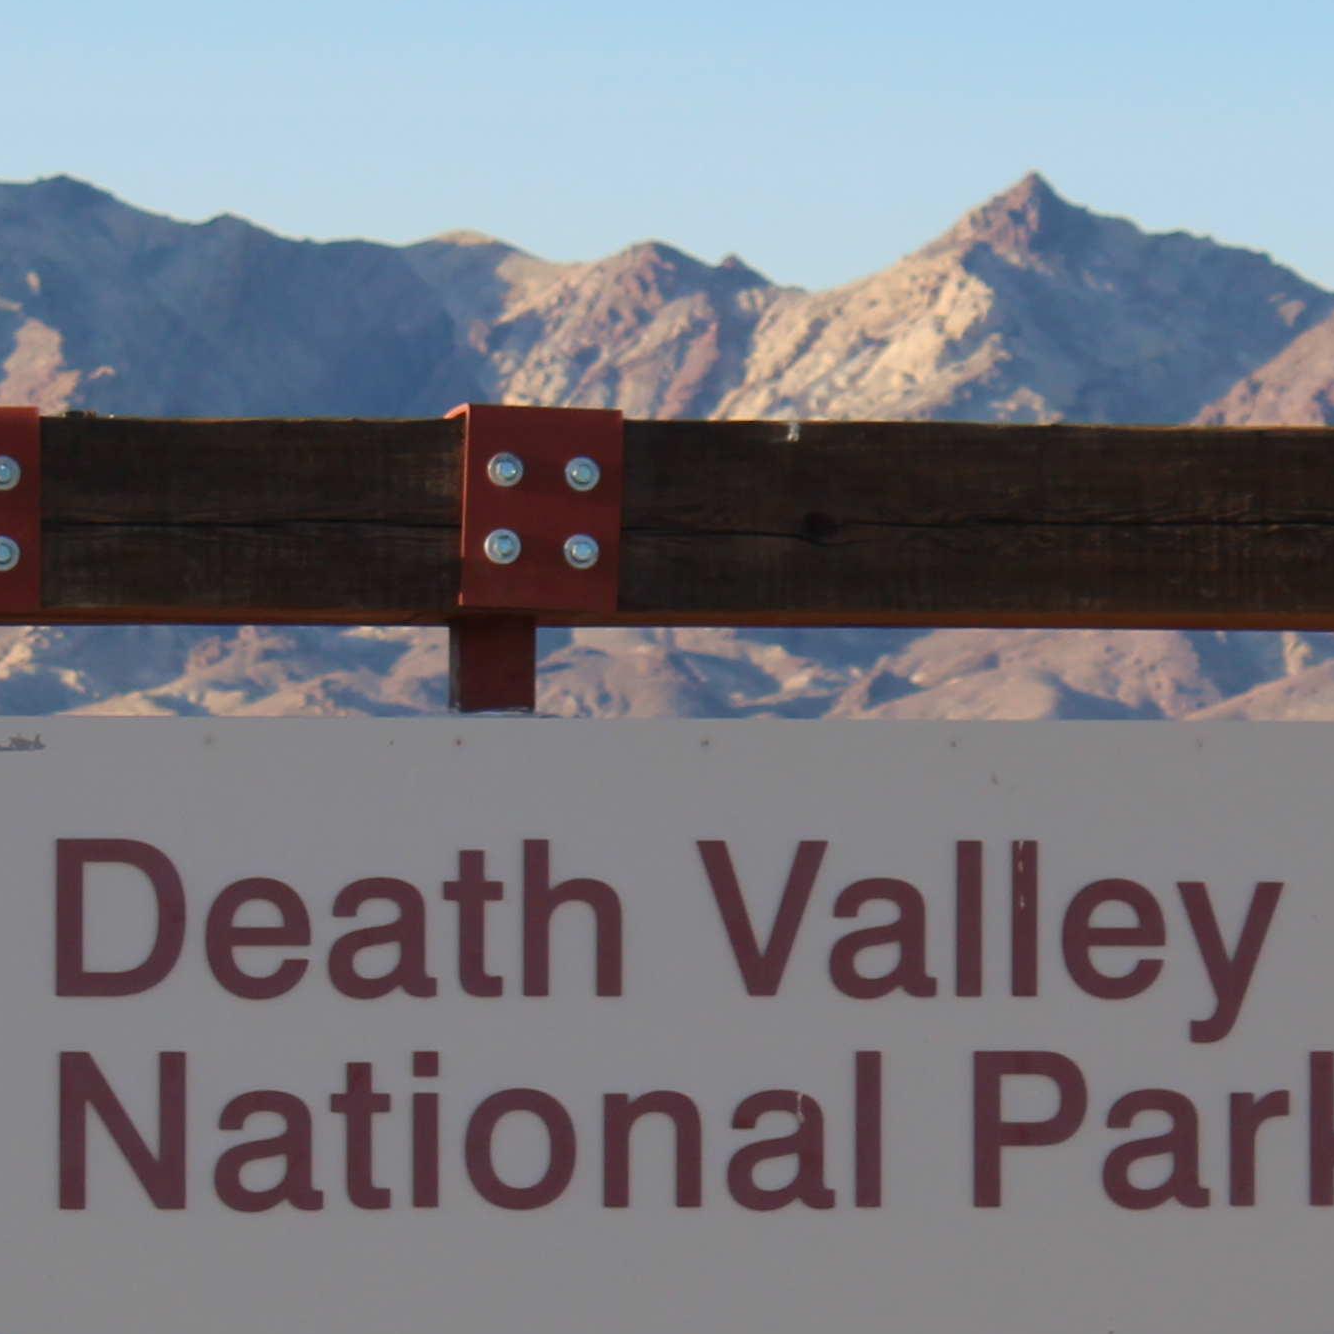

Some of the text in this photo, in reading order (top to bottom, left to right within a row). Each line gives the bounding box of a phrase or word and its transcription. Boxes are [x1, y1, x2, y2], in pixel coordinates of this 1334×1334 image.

[55, 838, 1285, 1044] Death Valley
[58, 1051, 882, 1213] National
